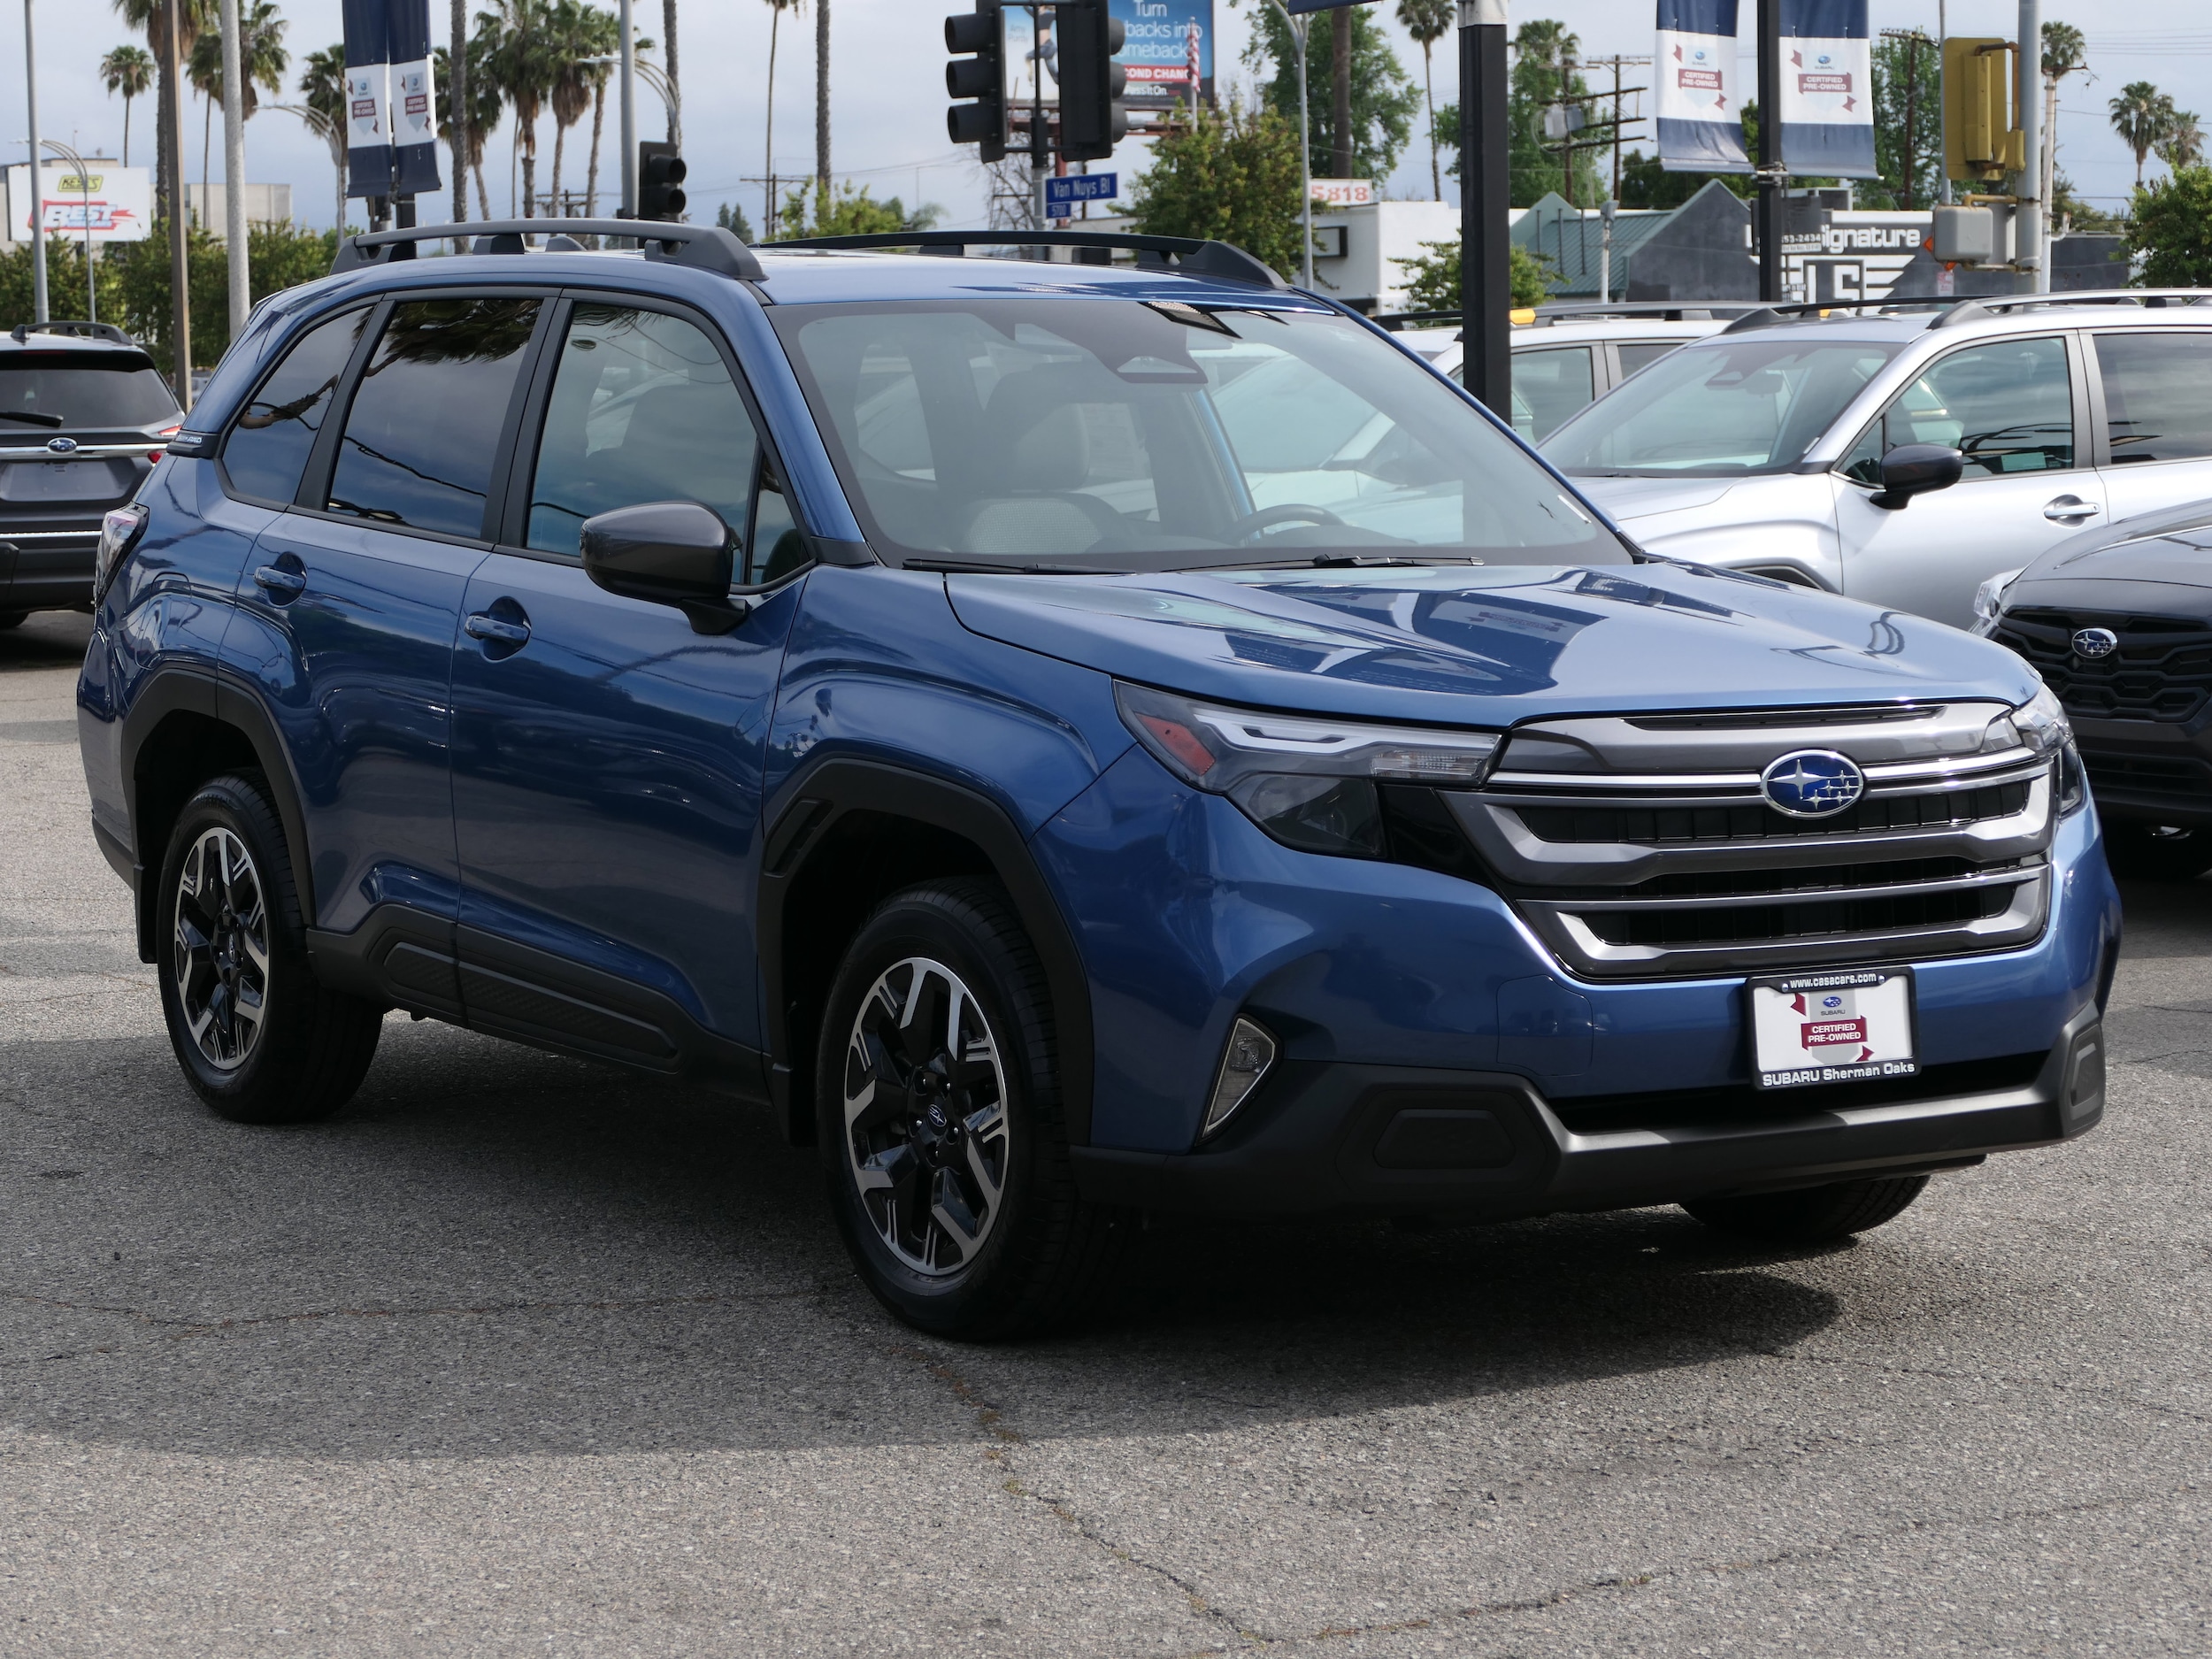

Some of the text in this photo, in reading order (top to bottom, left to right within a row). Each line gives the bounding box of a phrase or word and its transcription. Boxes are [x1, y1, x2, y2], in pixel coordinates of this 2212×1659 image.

[1133, 0, 1168, 18] Turn
[1124, 19, 1172, 38] backs
[1118, 42, 1189, 58] omeback
[1125, 68, 1189, 79] COND CHANC
[1685, 71, 1716, 81] CERTIFIED
[1682, 78, 1718, 88] PRE-OWNED
[1052, 180, 1071, 198] Van
[1072, 180, 1097, 200] Nuys
[1311, 185, 1369, 202] 5818
[1781, 233, 1822, 244] 53-2434
[1790, 972, 1877, 989] www.casacars.com
[1811, 1022, 1857, 1034] CERTIFIED
[1808, 1031, 1862, 1043] PRE-OWNED
[1763, 1061, 1916, 1087] SUBARU Sherman Oaks
